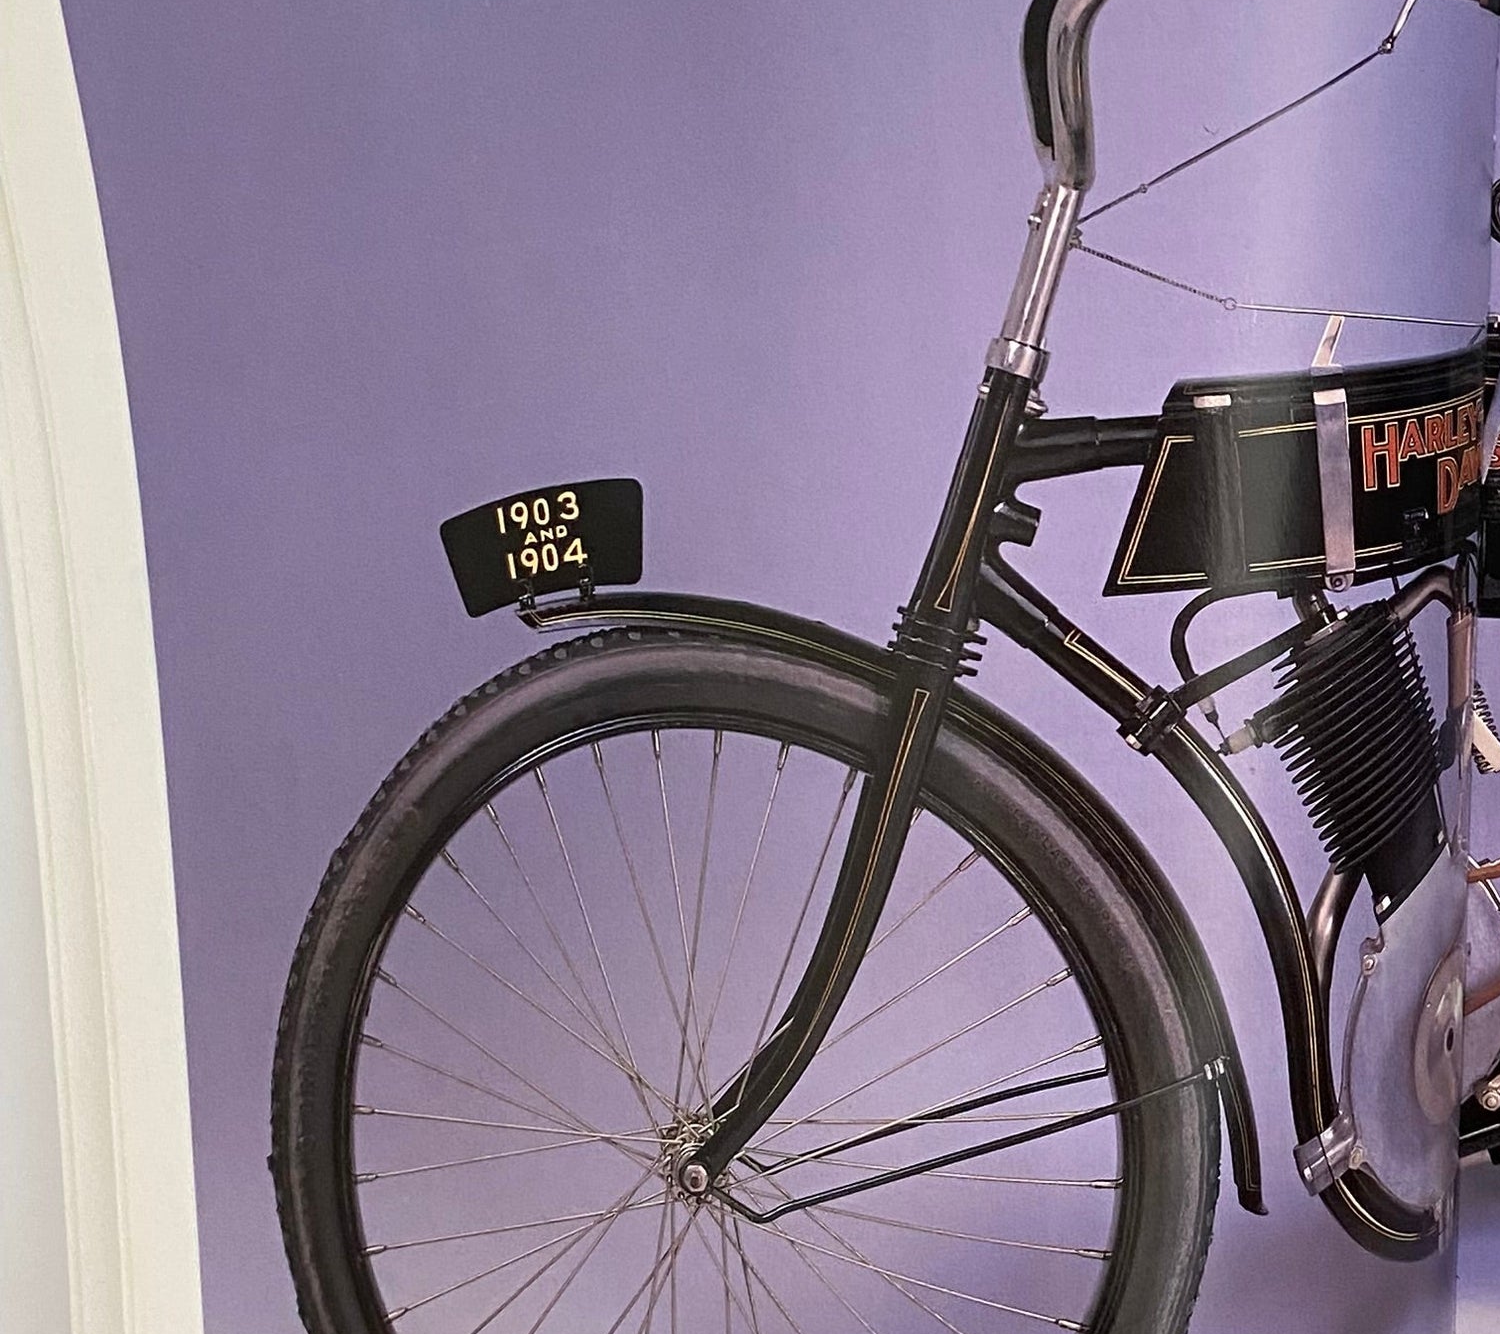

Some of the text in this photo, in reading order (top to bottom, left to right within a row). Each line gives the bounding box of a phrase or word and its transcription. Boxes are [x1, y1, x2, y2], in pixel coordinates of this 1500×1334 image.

[496, 491, 580, 534] 1903
[524, 525, 568, 546] AND
[507, 537, 588, 580] 1904
